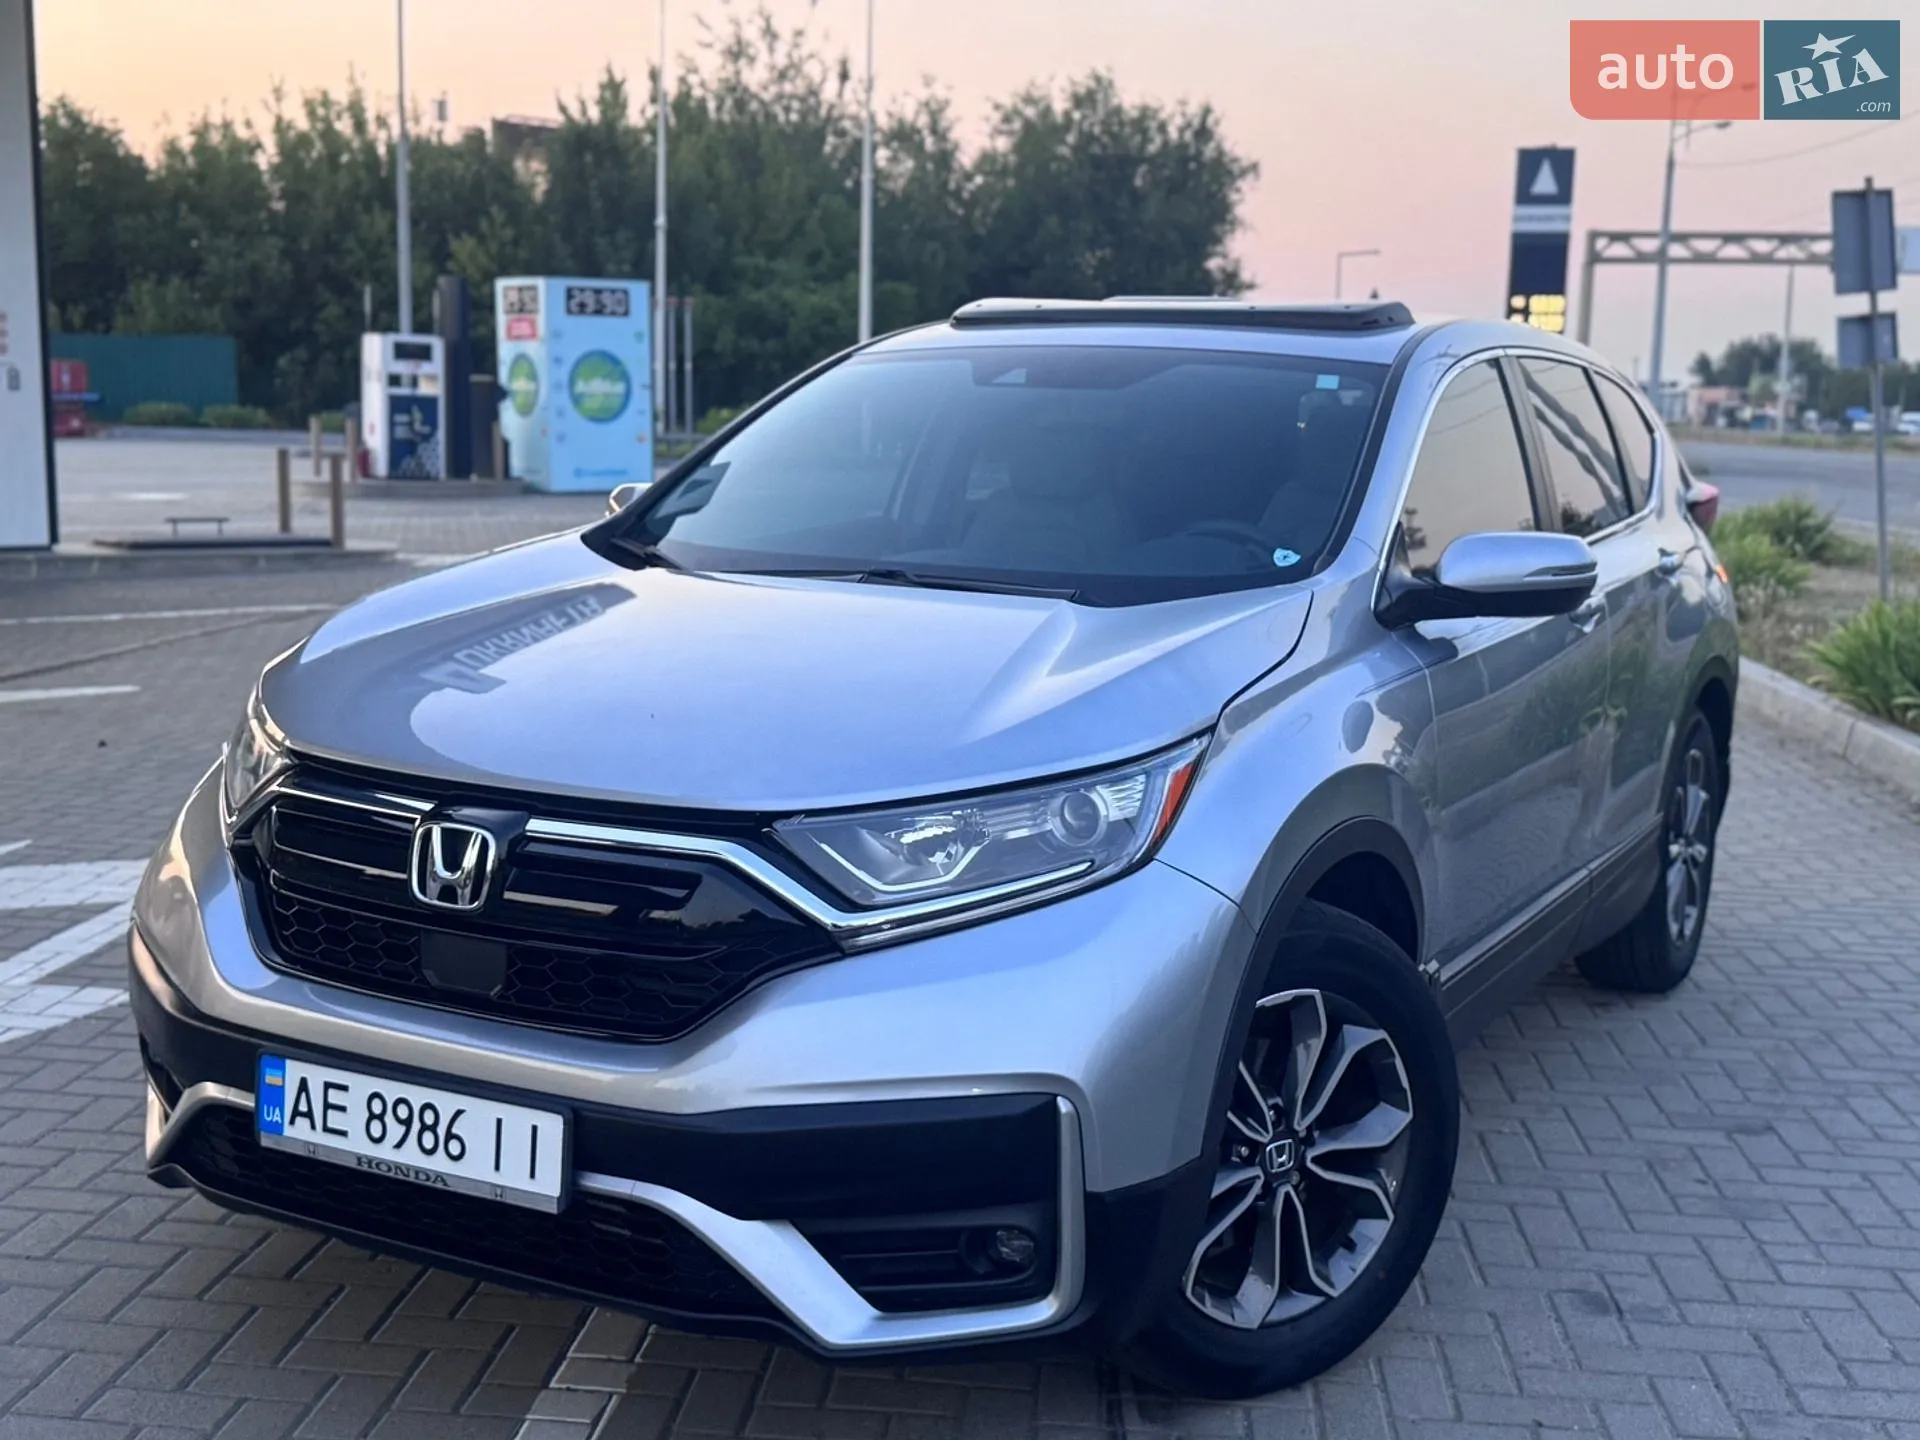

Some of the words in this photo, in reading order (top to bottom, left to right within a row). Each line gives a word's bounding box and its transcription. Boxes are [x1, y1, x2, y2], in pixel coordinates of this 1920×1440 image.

[263, 1104, 282, 1124] UA
[289, 1076, 349, 1138] AE
[365, 1091, 466, 1162] 8986
[356, 1155, 449, 1187] HONDA
